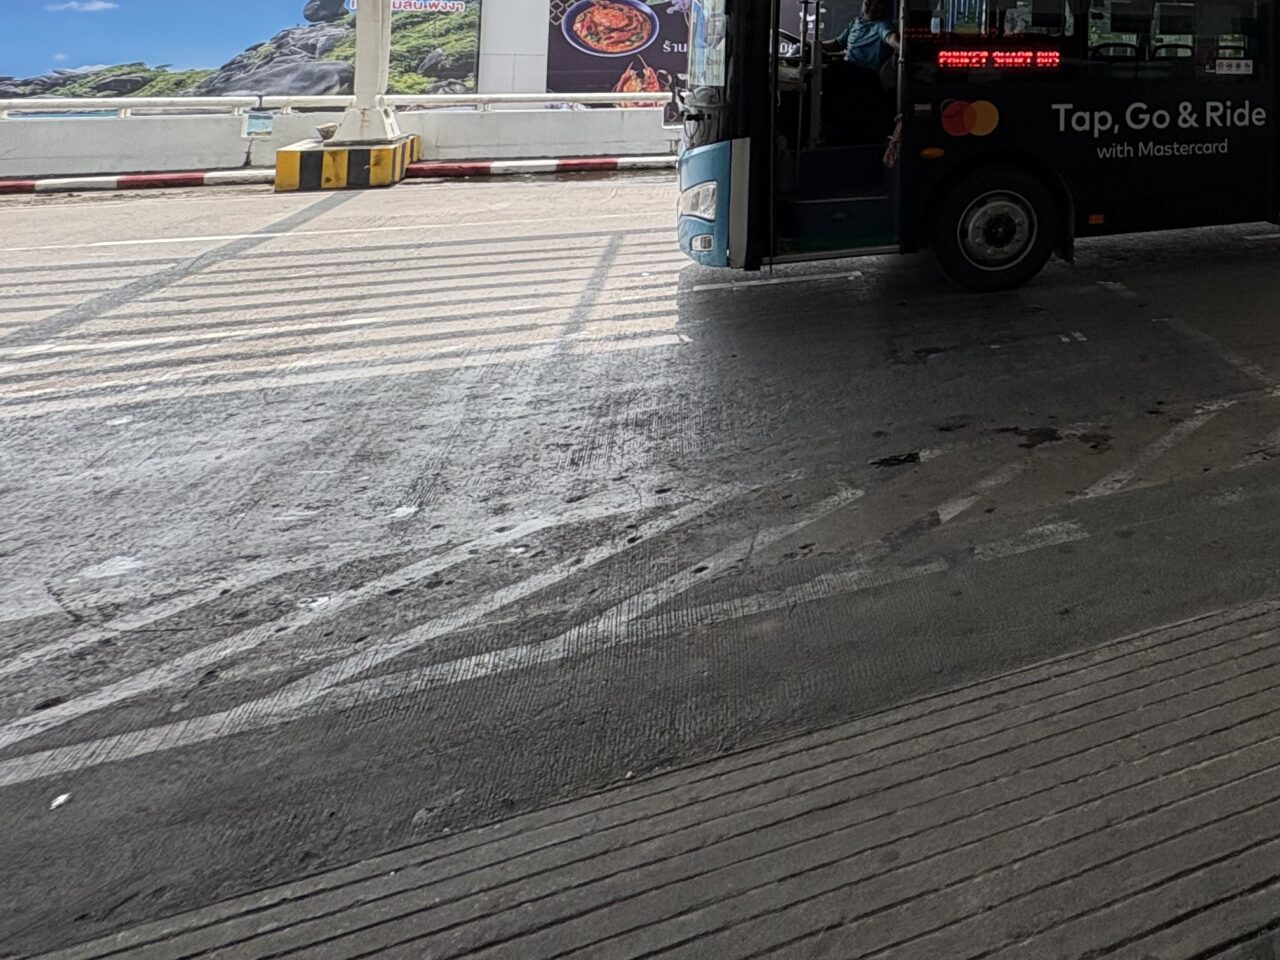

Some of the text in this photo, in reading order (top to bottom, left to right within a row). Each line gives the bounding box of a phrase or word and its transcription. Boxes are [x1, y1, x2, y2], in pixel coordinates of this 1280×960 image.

[1051, 99, 1267, 138] Tap, Go & Ride
[1096, 138, 1229, 159] with Mastercard
